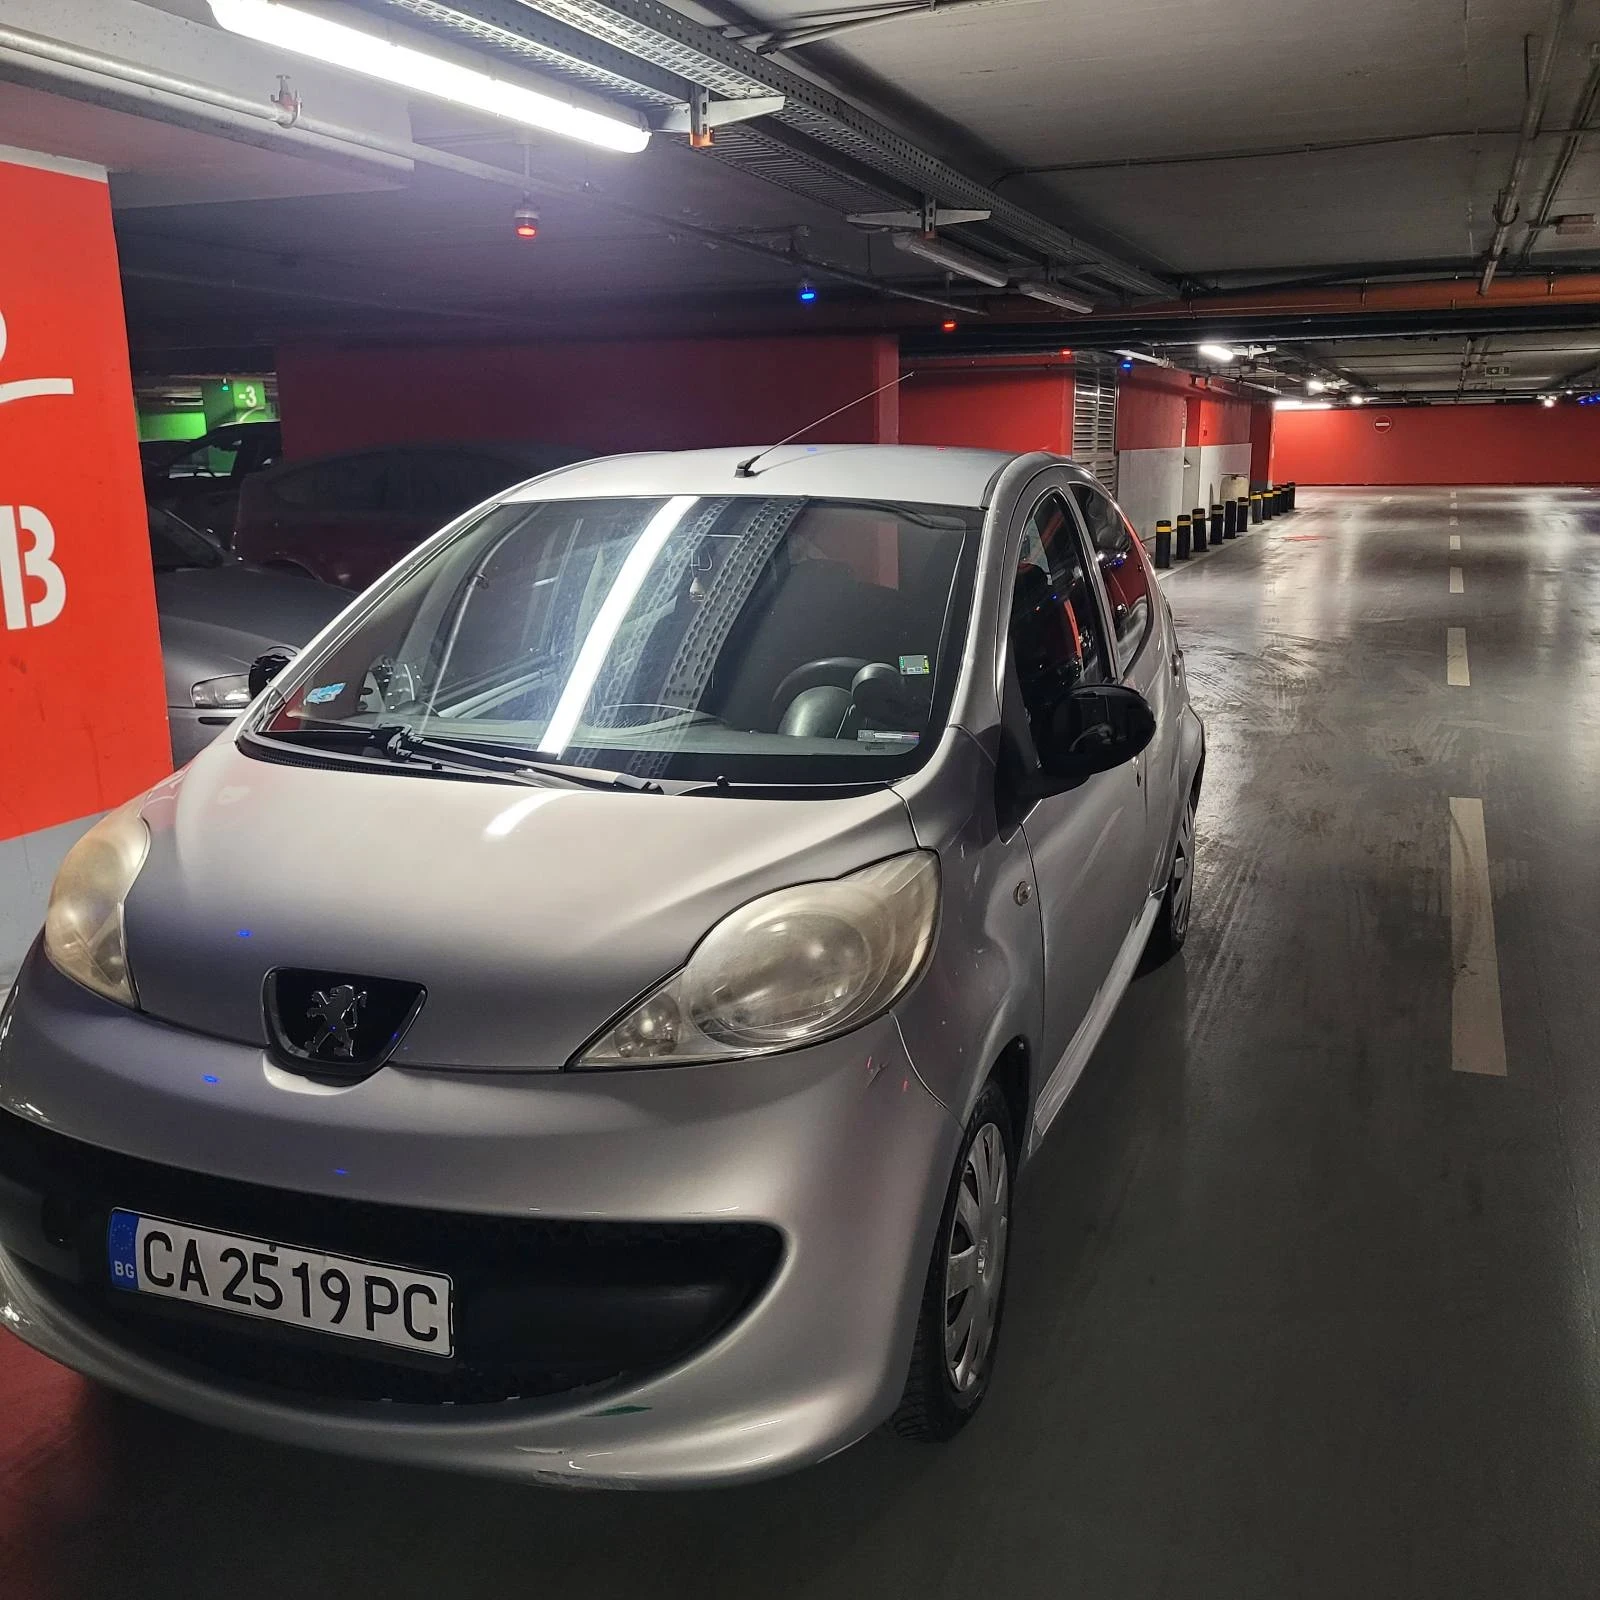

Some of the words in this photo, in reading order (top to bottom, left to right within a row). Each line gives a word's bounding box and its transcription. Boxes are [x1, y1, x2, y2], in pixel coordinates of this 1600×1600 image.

[238, 385, 257, 408] -3
[114, 1260, 135, 1279] BG
[143, 1230, 209, 1297] CA
[219, 1247, 351, 1325] 2519
[365, 1275, 438, 1342] PC
